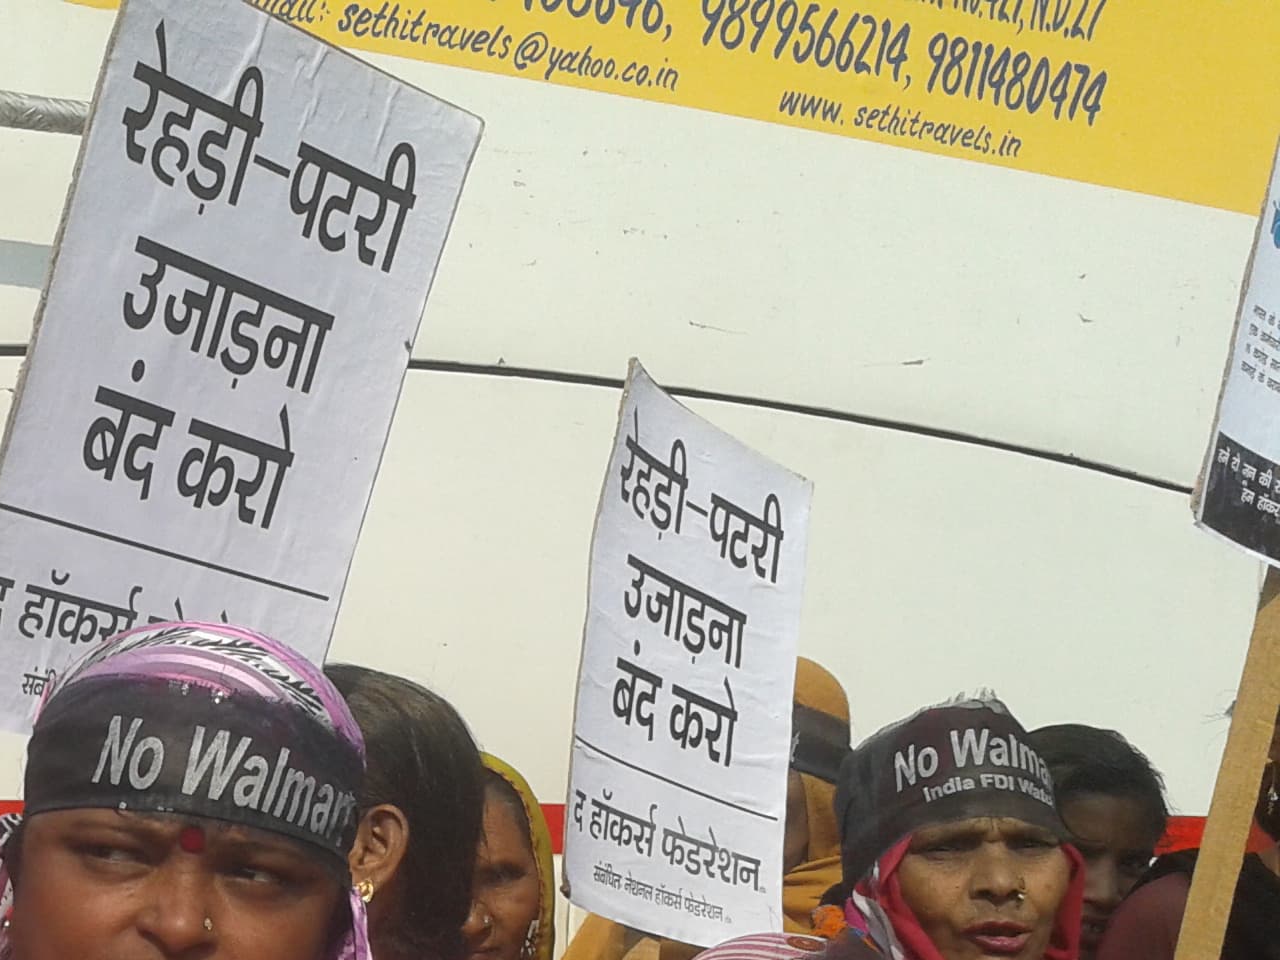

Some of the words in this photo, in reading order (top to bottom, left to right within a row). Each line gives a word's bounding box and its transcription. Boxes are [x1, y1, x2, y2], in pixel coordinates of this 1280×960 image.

[338, 1, 679, 90] sethitravels@yahoo.co.in
[702, 0, 912, 89] 9899566214,
[926, 32, 1108, 125] 9811480474
[122, 19, 417, 272] रेहड़ी-पटरी
[122, 235, 335, 394] उजाड़ना
[83, 359, 176, 499] बंद
[177, 404, 295, 529] करो
[621, 408, 783, 584] रेहड़ी-पटरी
[624, 554, 747, 669] उजाड़ना
[91, 715, 164, 790] No
[613, 640, 662, 741] बंद
[671, 676, 738, 767] करो
[894, 744, 938, 792] No
[922, 776, 975, 802] India
[980, 774, 1014, 791] FDI
[574, 789, 587, 832] द
[589, 788, 657, 857] हॉकर्स
[662, 816, 761, 891] फेडरेशन
